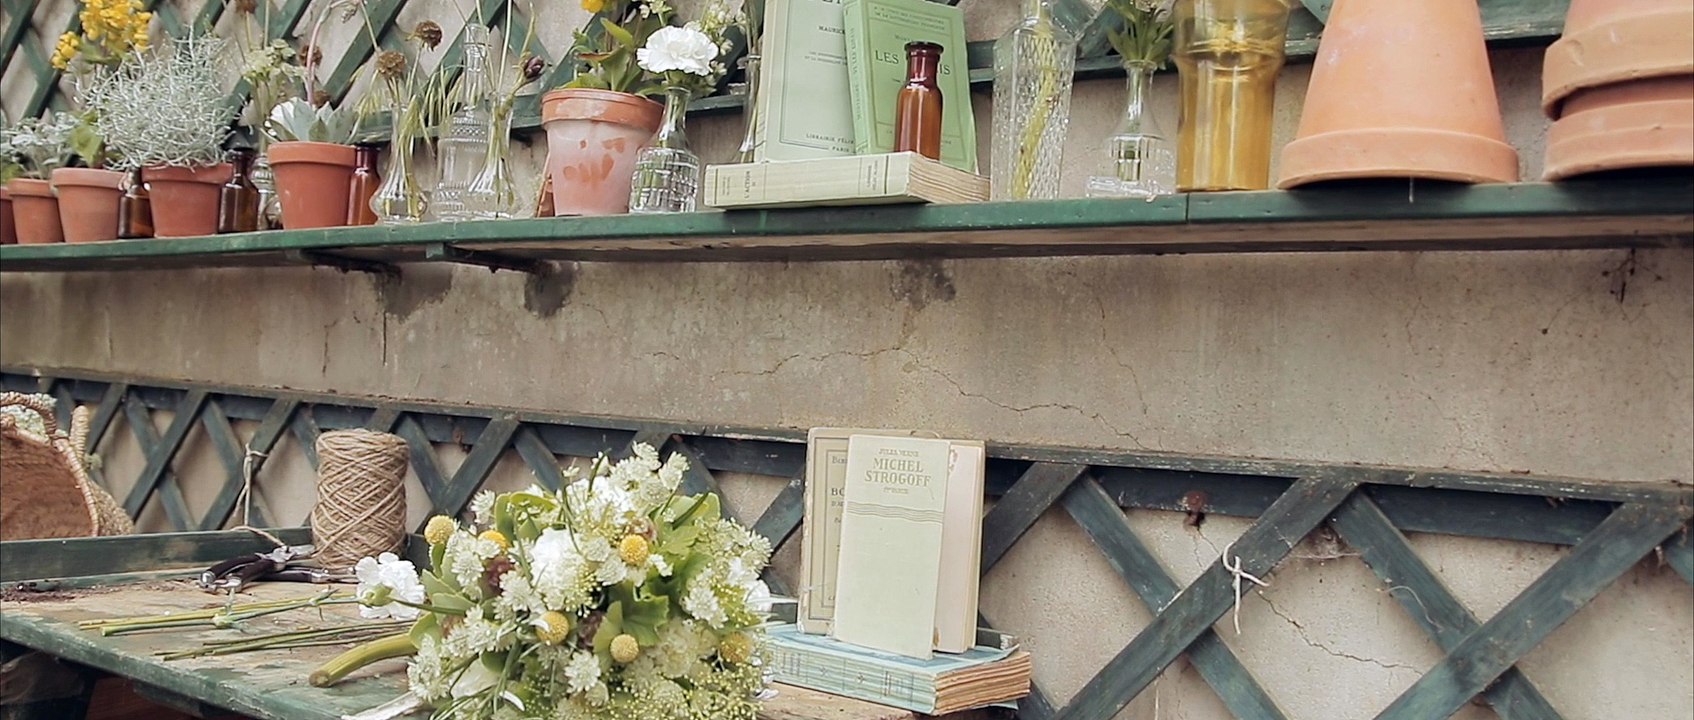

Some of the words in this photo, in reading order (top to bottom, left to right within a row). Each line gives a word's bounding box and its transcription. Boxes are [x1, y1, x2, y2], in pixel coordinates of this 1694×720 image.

[875, 50, 899, 64] LES
[873, 457, 924, 473] MICHEL
[864, 470, 932, 487] STROGOFF
